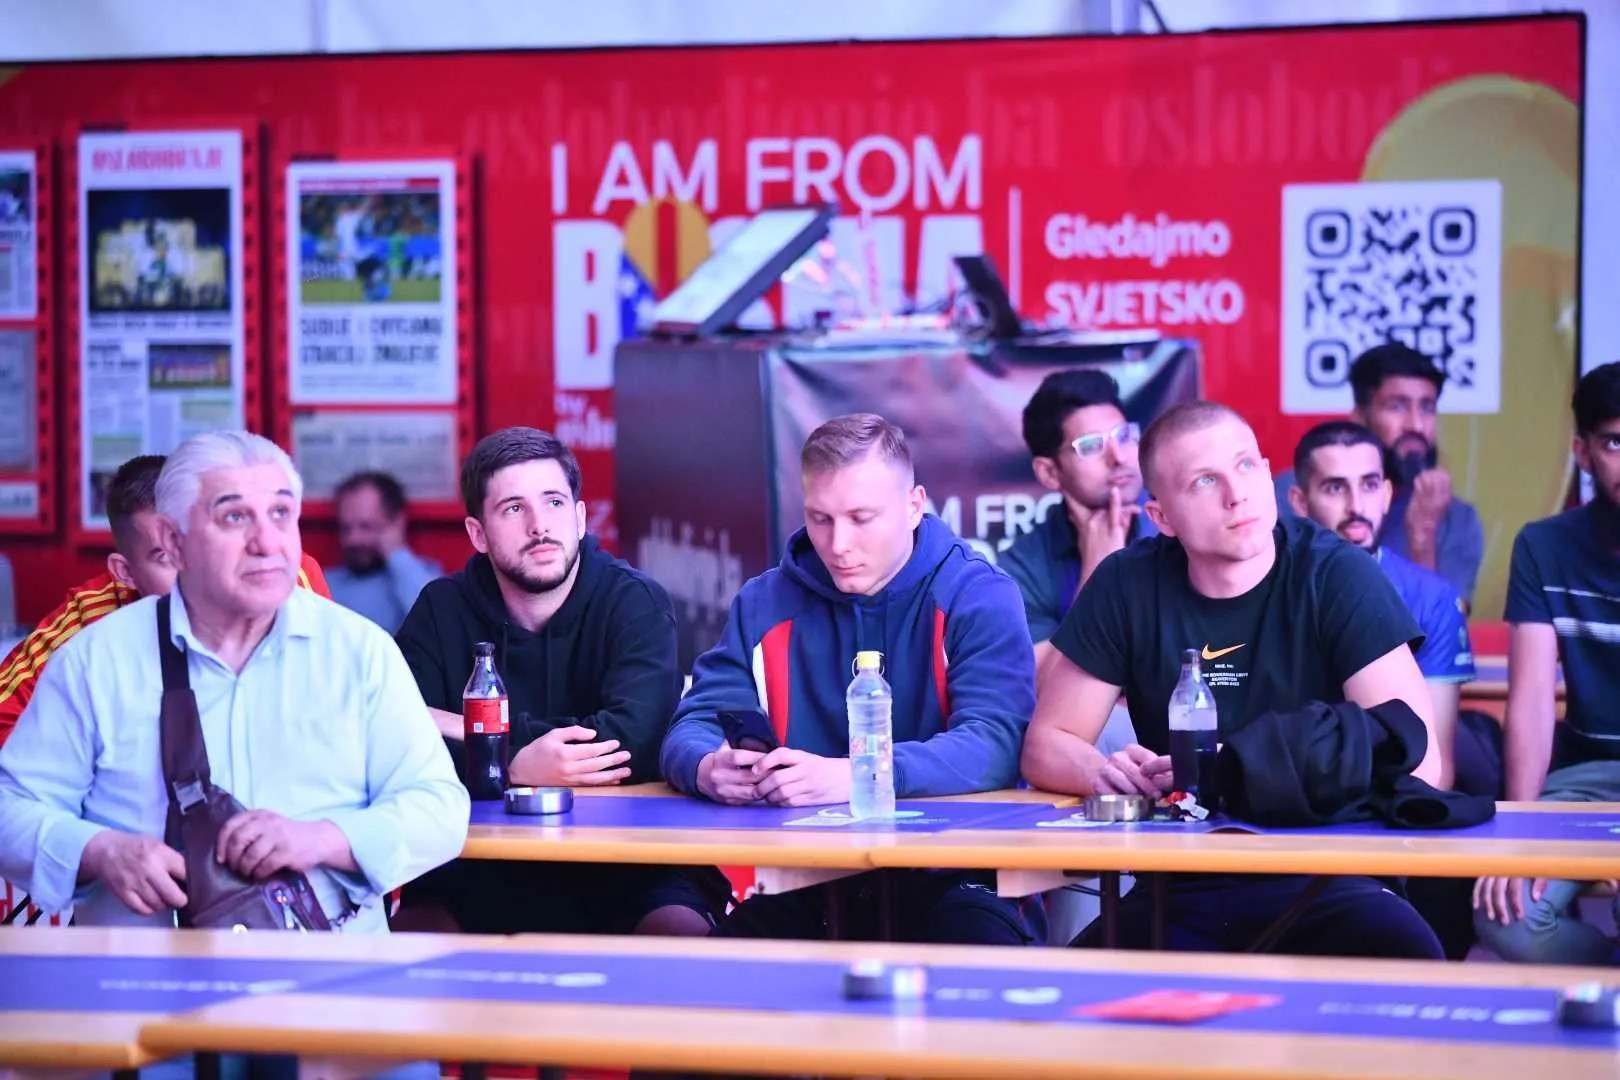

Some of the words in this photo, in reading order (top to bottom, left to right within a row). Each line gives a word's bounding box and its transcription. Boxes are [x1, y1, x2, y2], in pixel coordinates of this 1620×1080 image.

[551, 141, 568, 214] I
[592, 140, 718, 214] AM
[745, 133, 983, 212] FROM
[1044, 212, 1232, 269] Gledajmo
[1044, 279, 1245, 326] SVJETSKO
[975, 491, 1063, 540] FR
